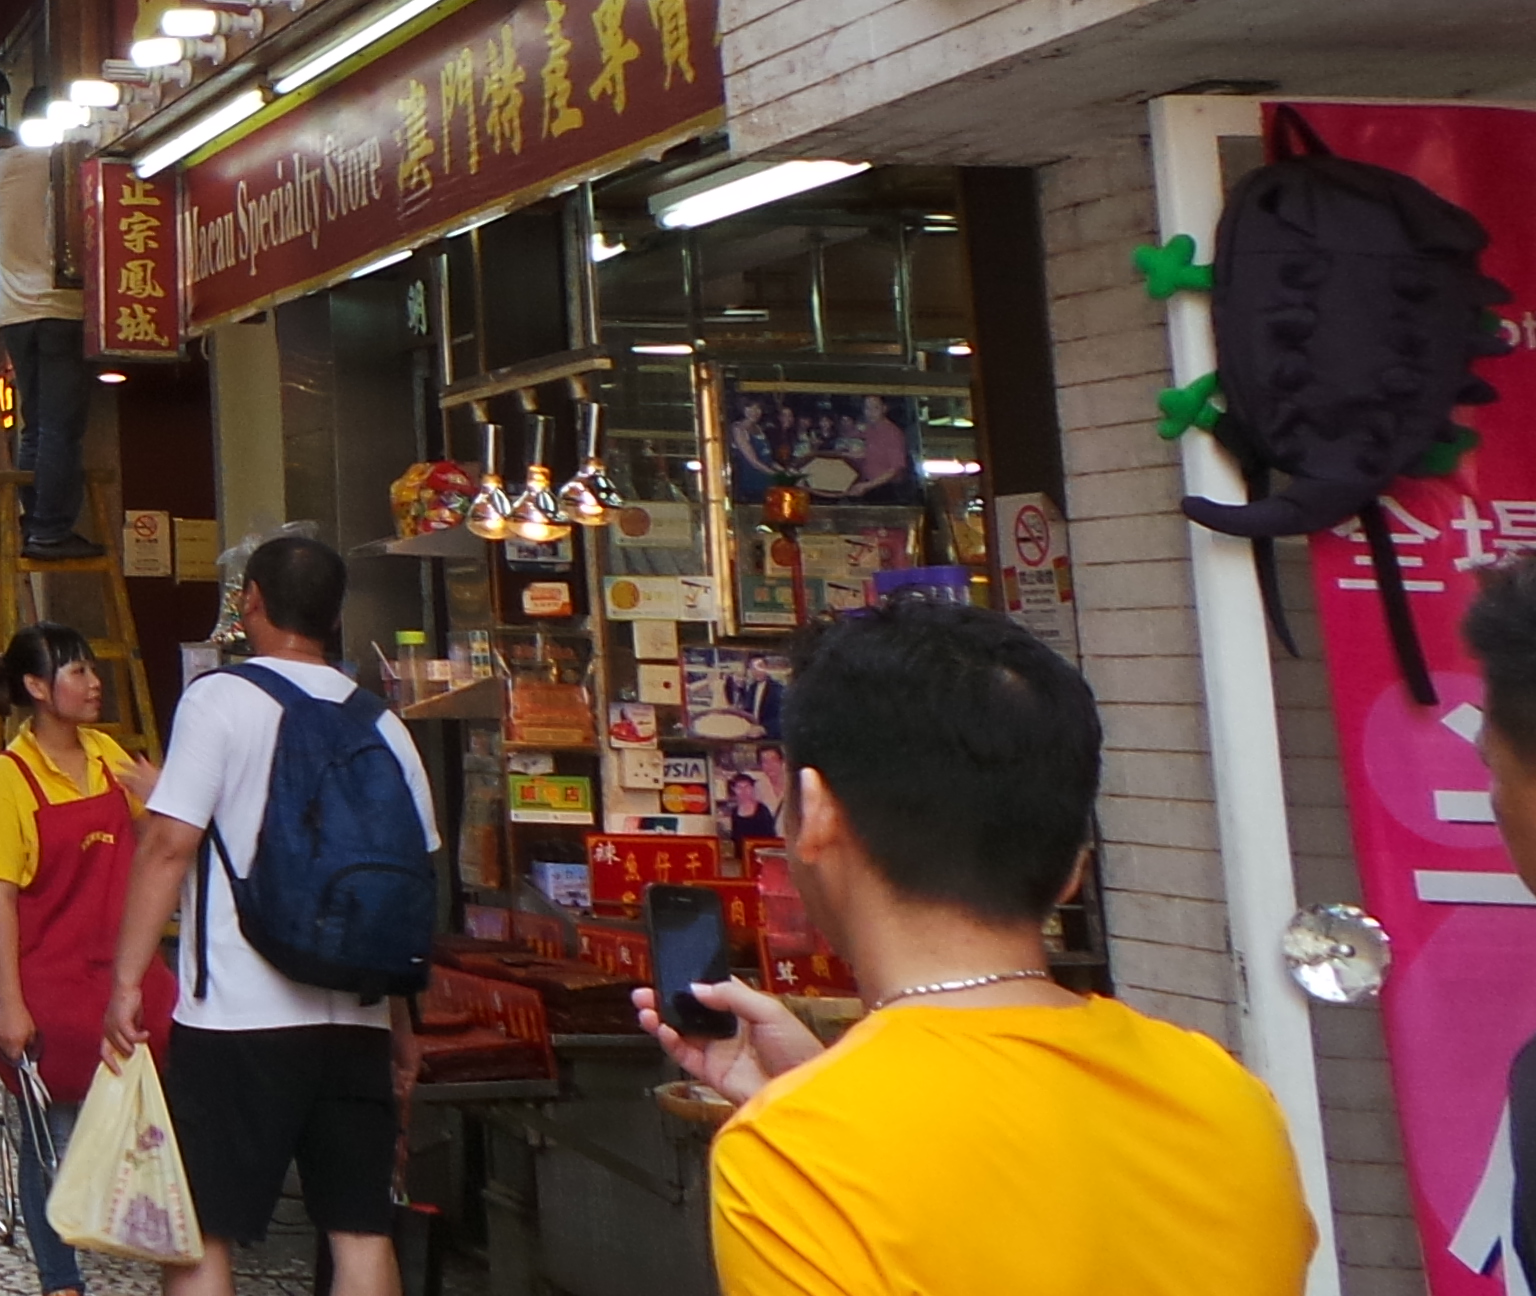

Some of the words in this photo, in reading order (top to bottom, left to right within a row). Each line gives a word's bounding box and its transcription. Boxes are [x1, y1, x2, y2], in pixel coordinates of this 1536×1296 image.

[115, 170, 170, 347] 正宗鳳城
[238, 151, 322, 277] Specialty
[323, 134, 382, 221] Store
